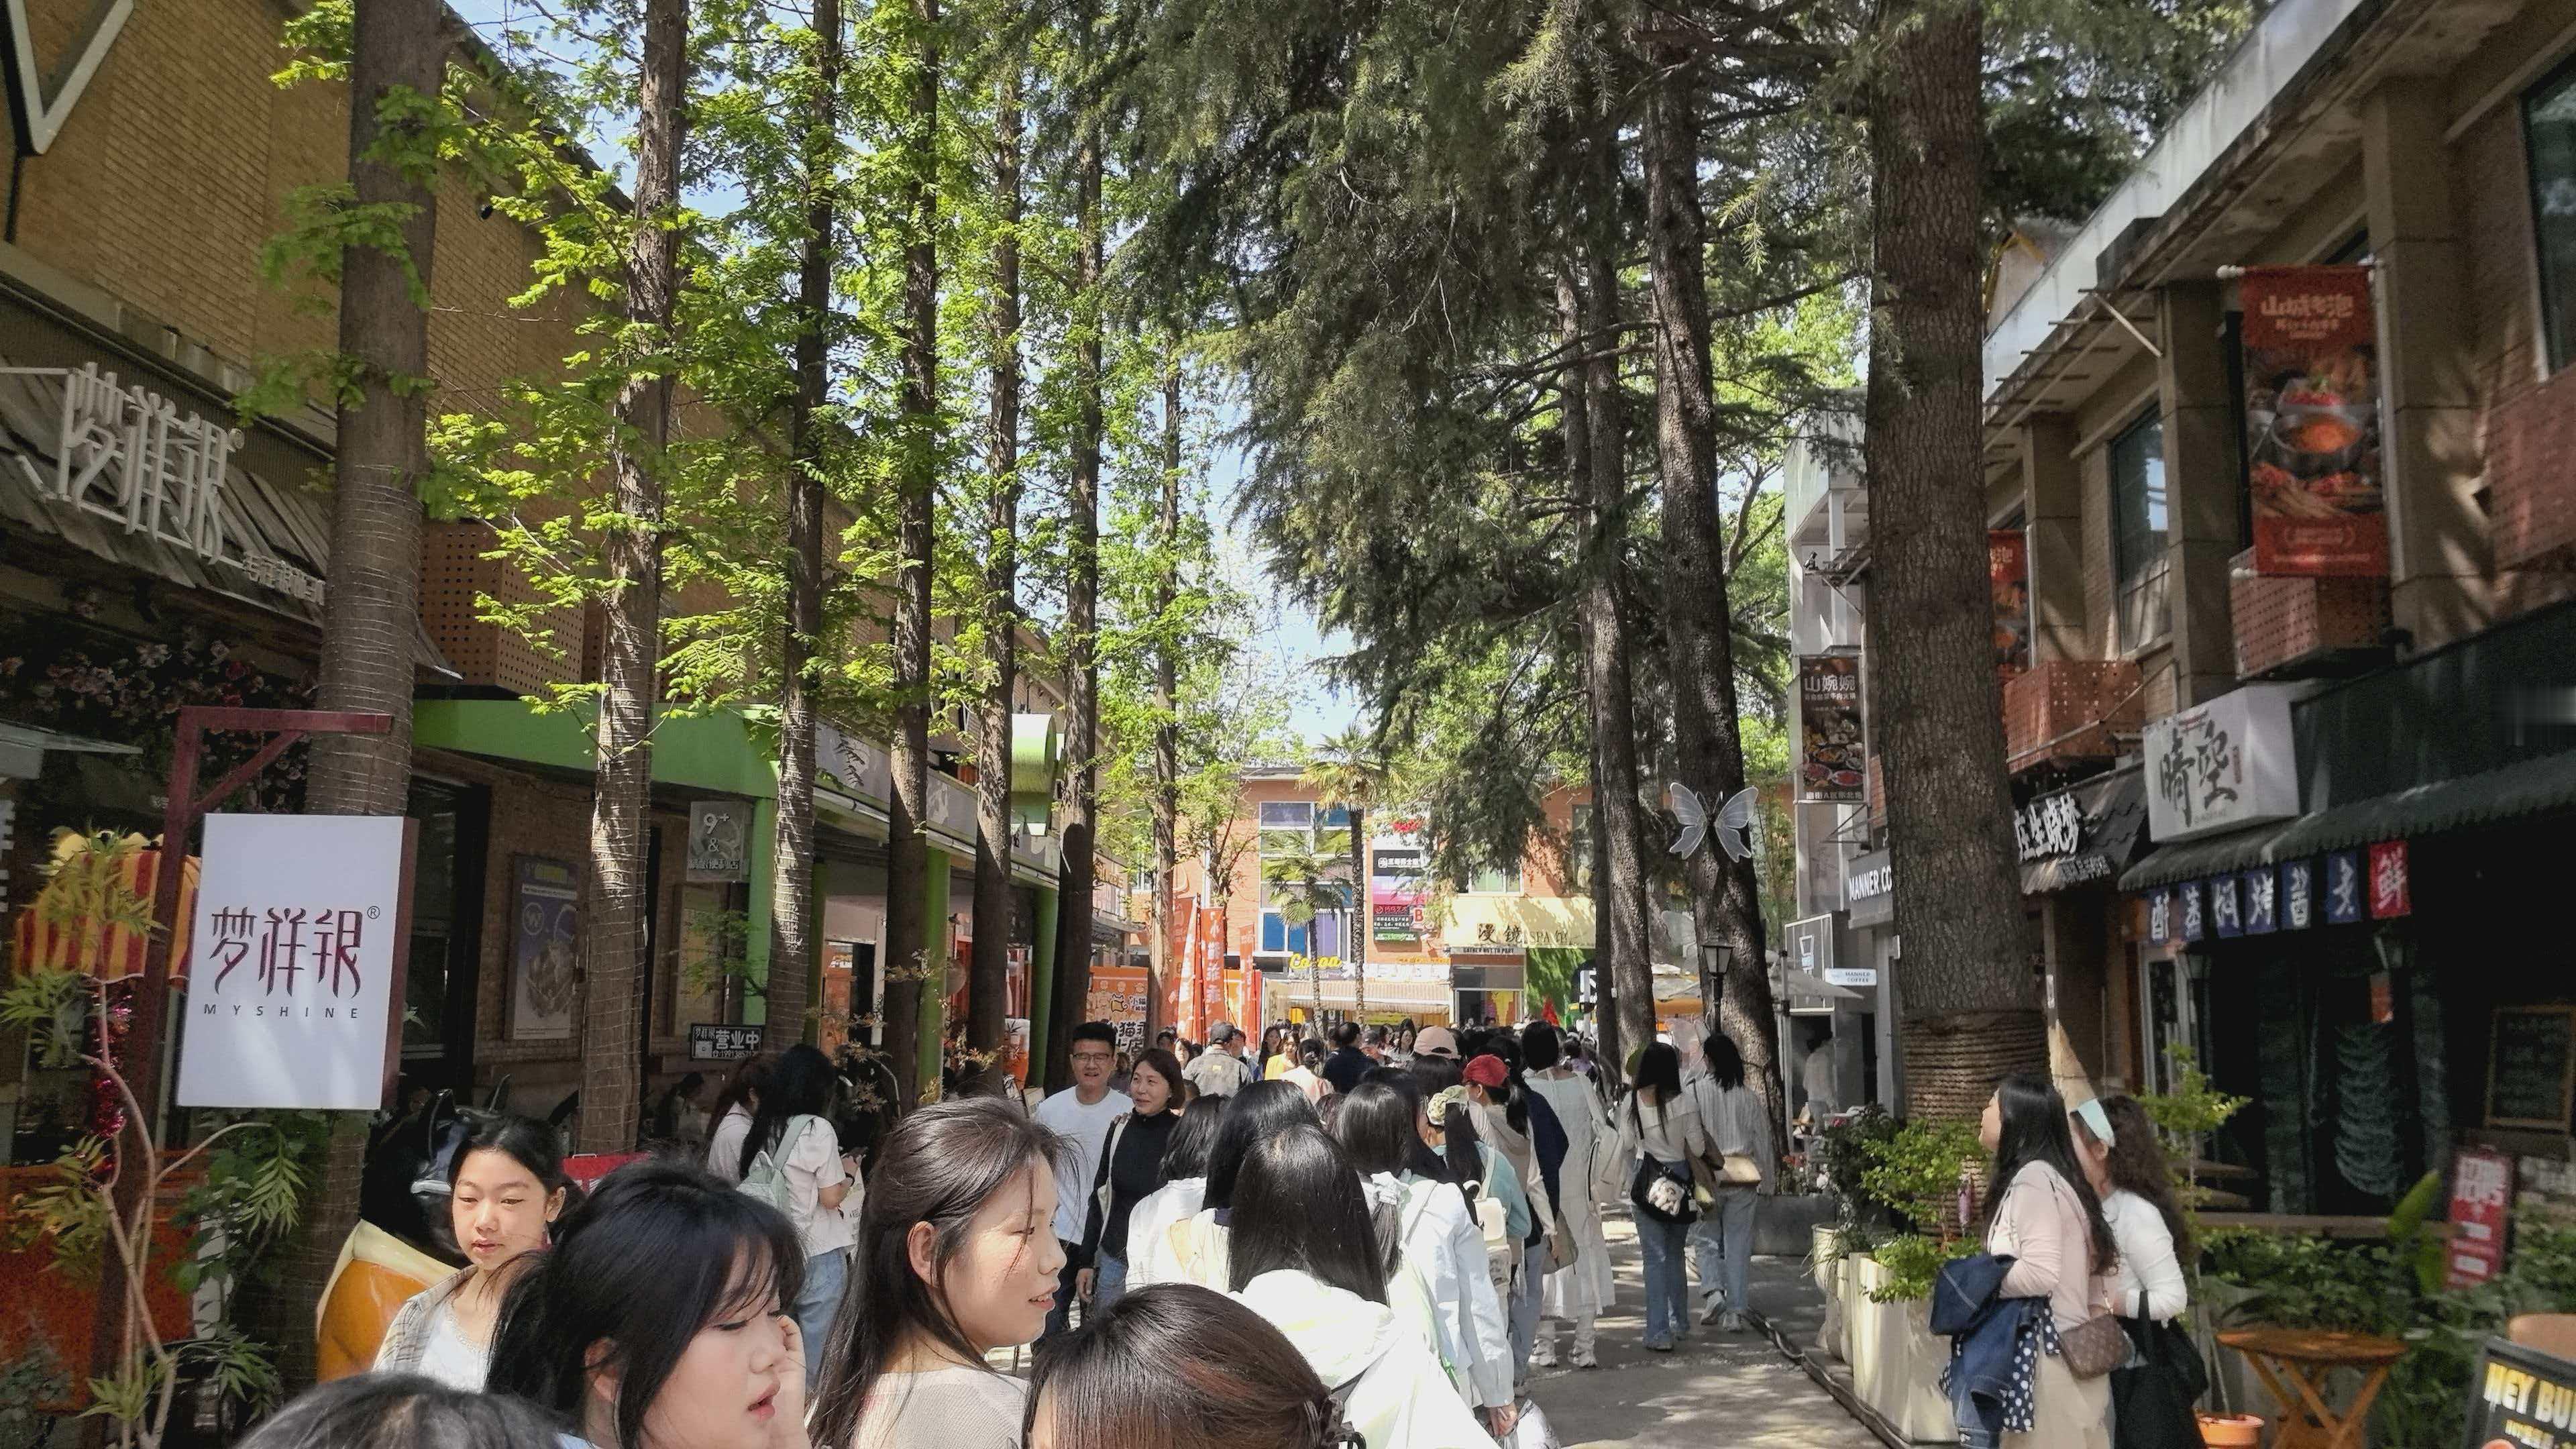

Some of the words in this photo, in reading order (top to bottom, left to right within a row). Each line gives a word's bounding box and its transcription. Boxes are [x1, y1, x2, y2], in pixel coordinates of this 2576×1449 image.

[1849, 869, 1879, 902] MANNER
[1532, 930, 1551, 943] SPA
[209, 906, 364, 998] 梦祥银
[203, 1003, 359, 1019] MYSHINE
[716, 1029, 759, 1050] 营业中
